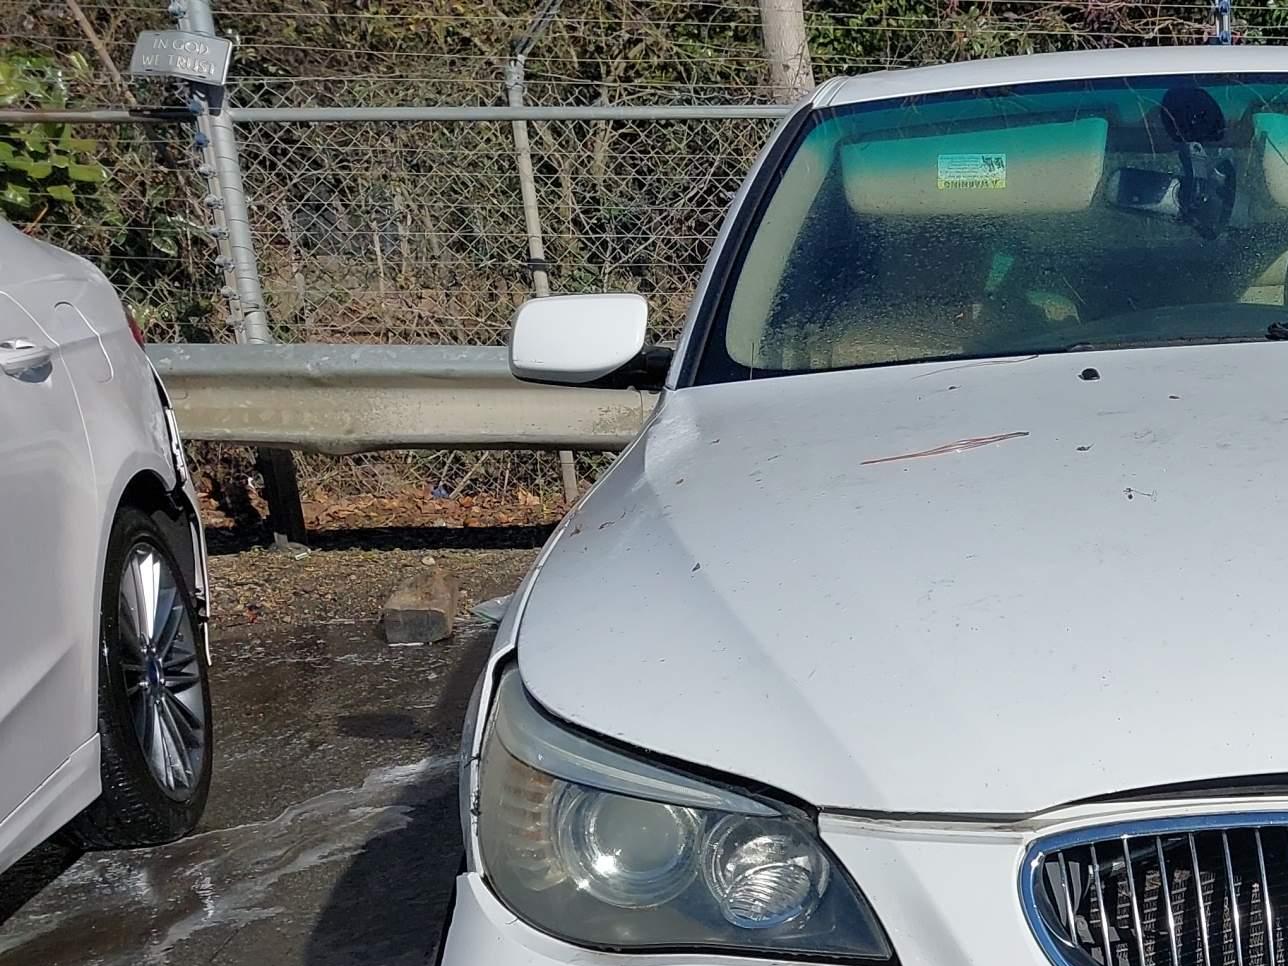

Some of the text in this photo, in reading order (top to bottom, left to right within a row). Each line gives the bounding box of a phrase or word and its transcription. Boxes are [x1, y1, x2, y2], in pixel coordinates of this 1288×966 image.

[152, 38, 209, 56] IN GOD
[168, 54, 215, 76] TRUST
